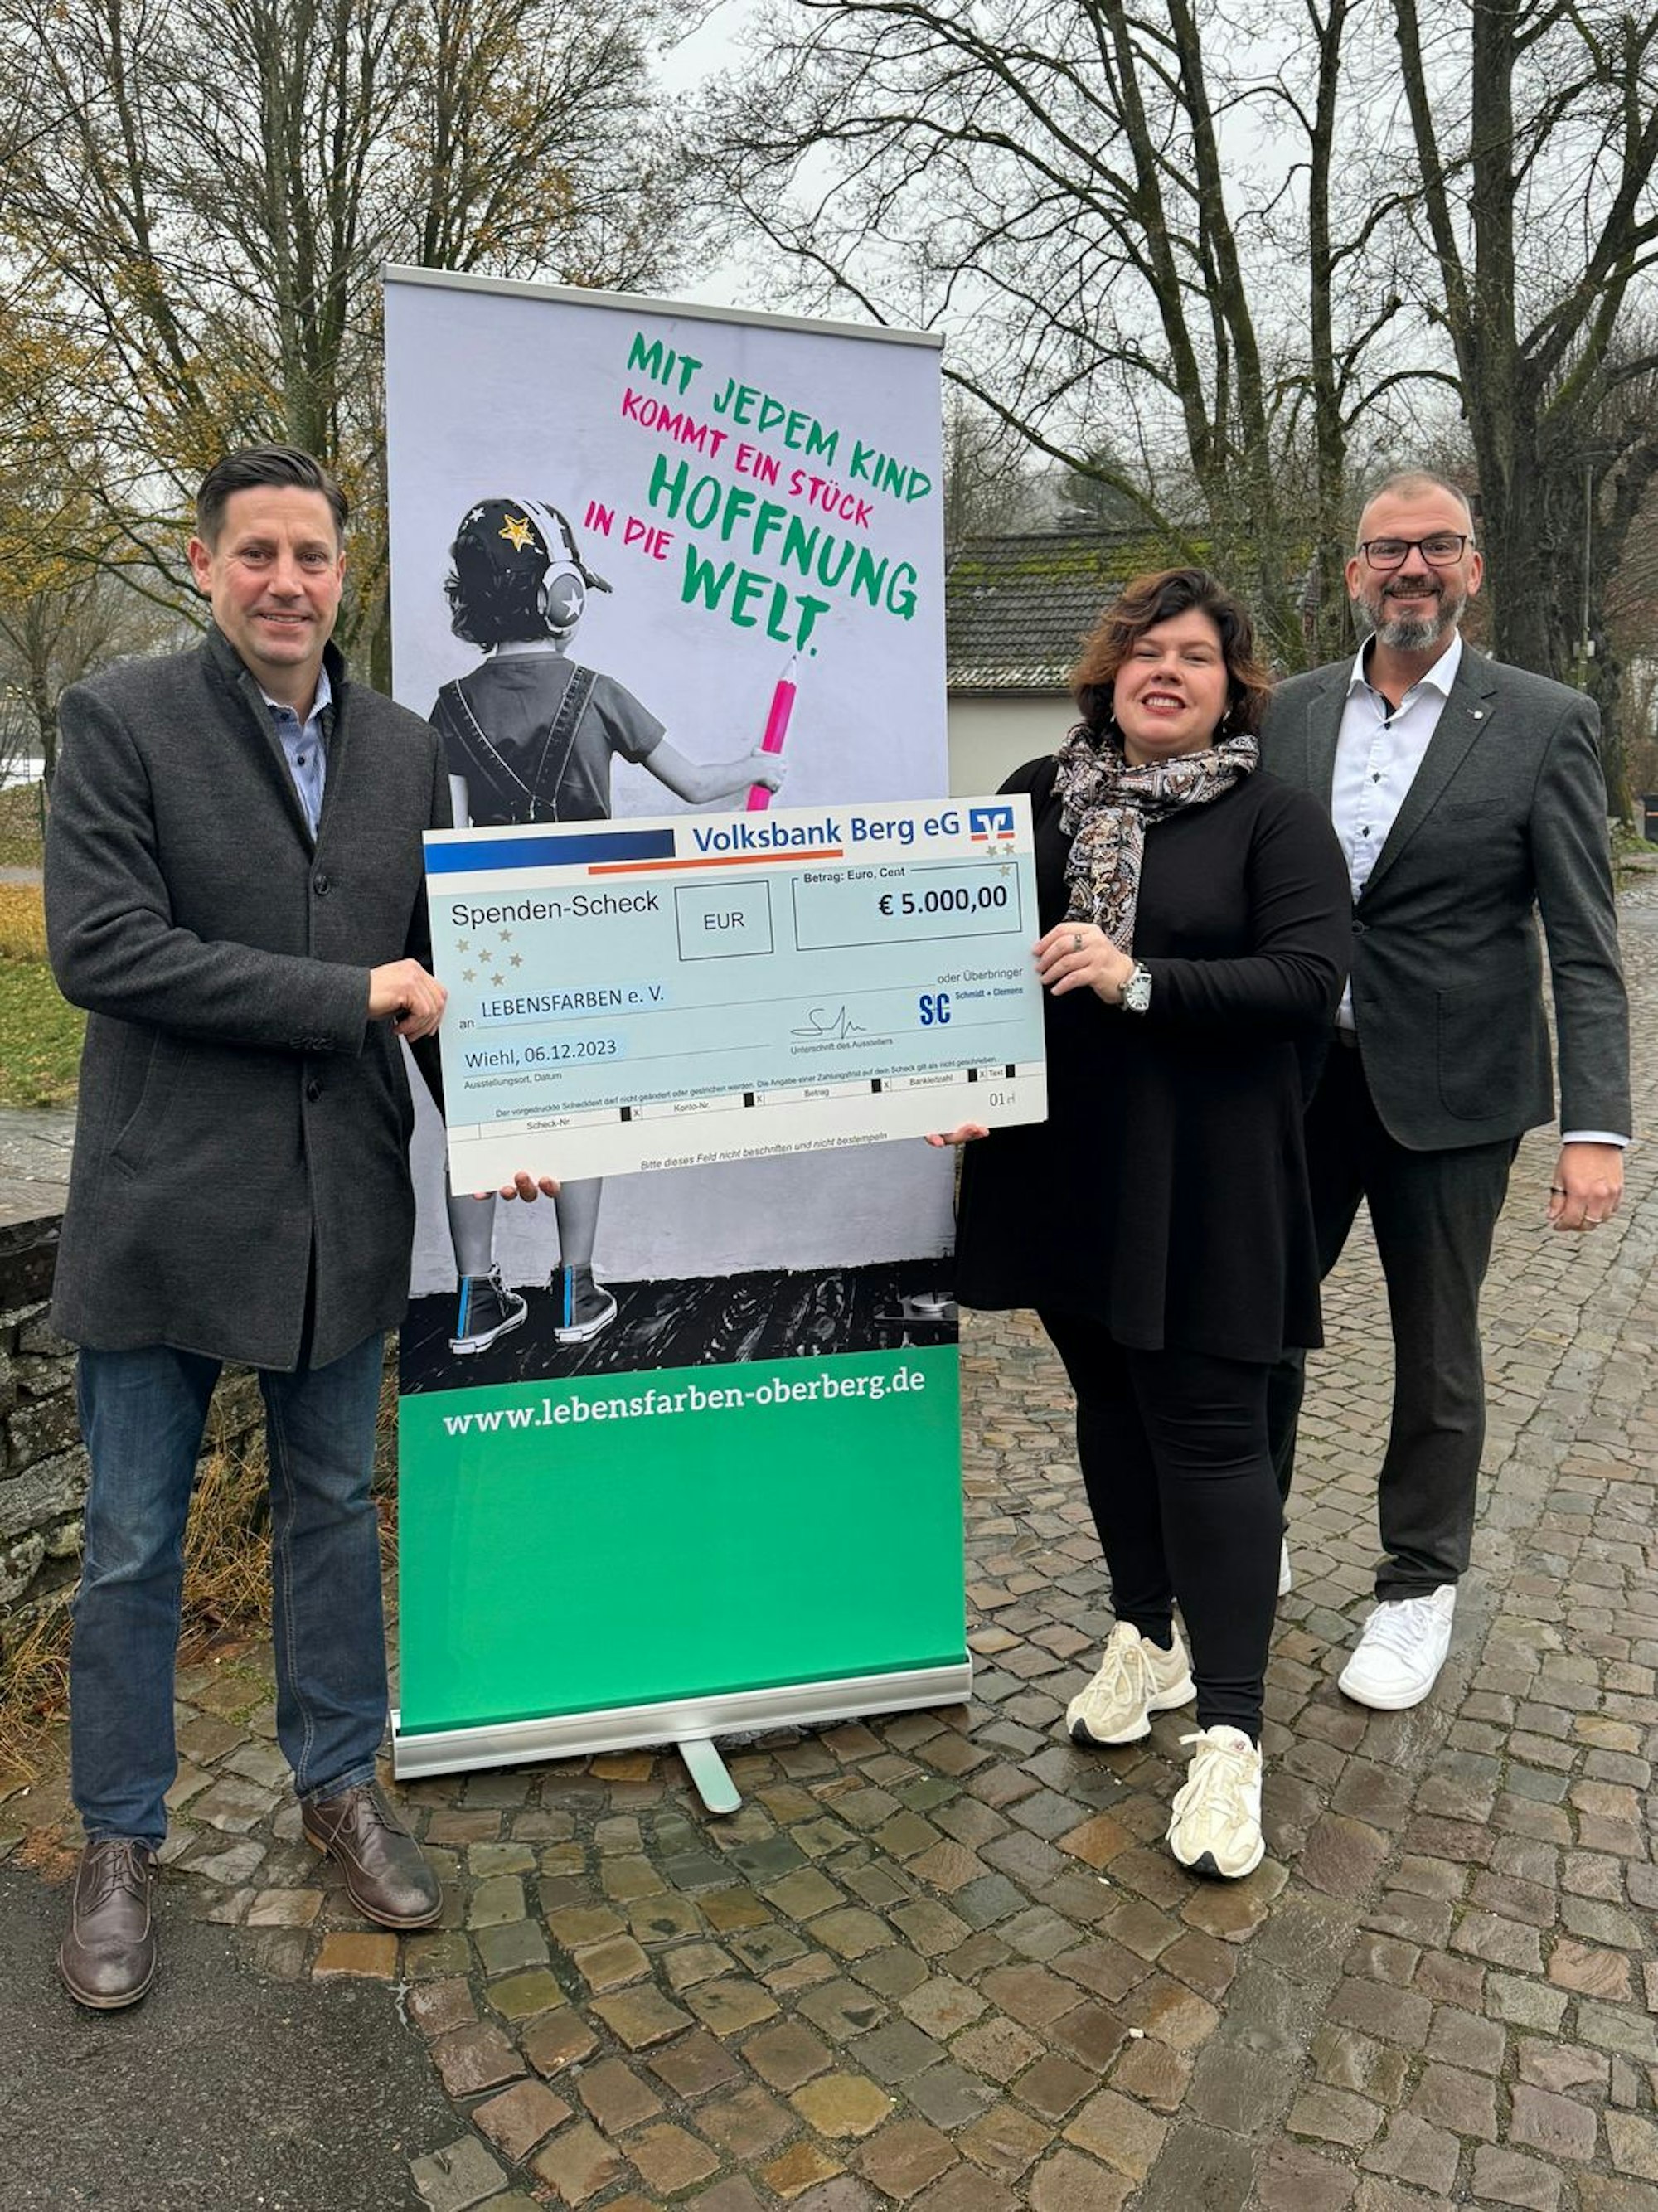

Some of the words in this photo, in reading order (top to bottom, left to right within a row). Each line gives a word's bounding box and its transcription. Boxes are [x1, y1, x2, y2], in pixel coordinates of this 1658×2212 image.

[626, 331, 703, 395] MIT
[713, 377, 840, 467] JEDEM
[849, 440, 932, 503] KIND
[621, 387, 728, 460] KOMMT
[734, 444, 781, 488] EIN
[789, 468, 874, 530] STÜCK
[648, 453, 919, 622] HOFFNUNG
[583, 501, 614, 536] IN
[623, 514, 675, 561] DIE
[681, 543, 830, 657] WELT.
[693, 817, 843, 853] Volksbank
[851, 816, 914, 846] Berg
[924, 812, 960, 836] eG
[803, 871, 845, 884] Betrag:
[847, 868, 877, 880] Euro,
[880, 866, 905, 878] Cent
[452, 890, 659, 929] Spenden-Scheck
[879, 895, 894, 915] €
[902, 885, 1007, 914] 5.000,00
[704, 912, 746, 930] EUR
[938, 972, 961, 984] oder
[963, 968, 1024, 982] Überbringer
[482, 989, 622, 1018] LEBENSFARBEN
[628, 987, 643, 1003] e.
[648, 985, 664, 1002] V.
[459, 1019, 475, 1030] an
[465, 1049, 520, 1069] Wiehl,
[525, 1040, 617, 1063] 06.12.2023
[791, 1042, 835, 1055] Unterschrift
[464, 1075, 532, 1089] Ausstellungsort,
[534, 1072, 562, 1083] Datum
[496, 1109, 510, 1118] Der
[620, 1094, 638, 1103] nicht
[672, 1089, 689, 1098] oder
[641, 1159, 662, 1171] Bitte
[664, 1156, 694, 1167] dieses
[696, 1152, 717, 1163] Feld
[719, 1149, 742, 1161] nicht
[794, 1141, 812, 1151] und
[813, 1138, 835, 1148] nicht
[444, 1366, 925, 1436] www.lebensfarben-oberberg.de
